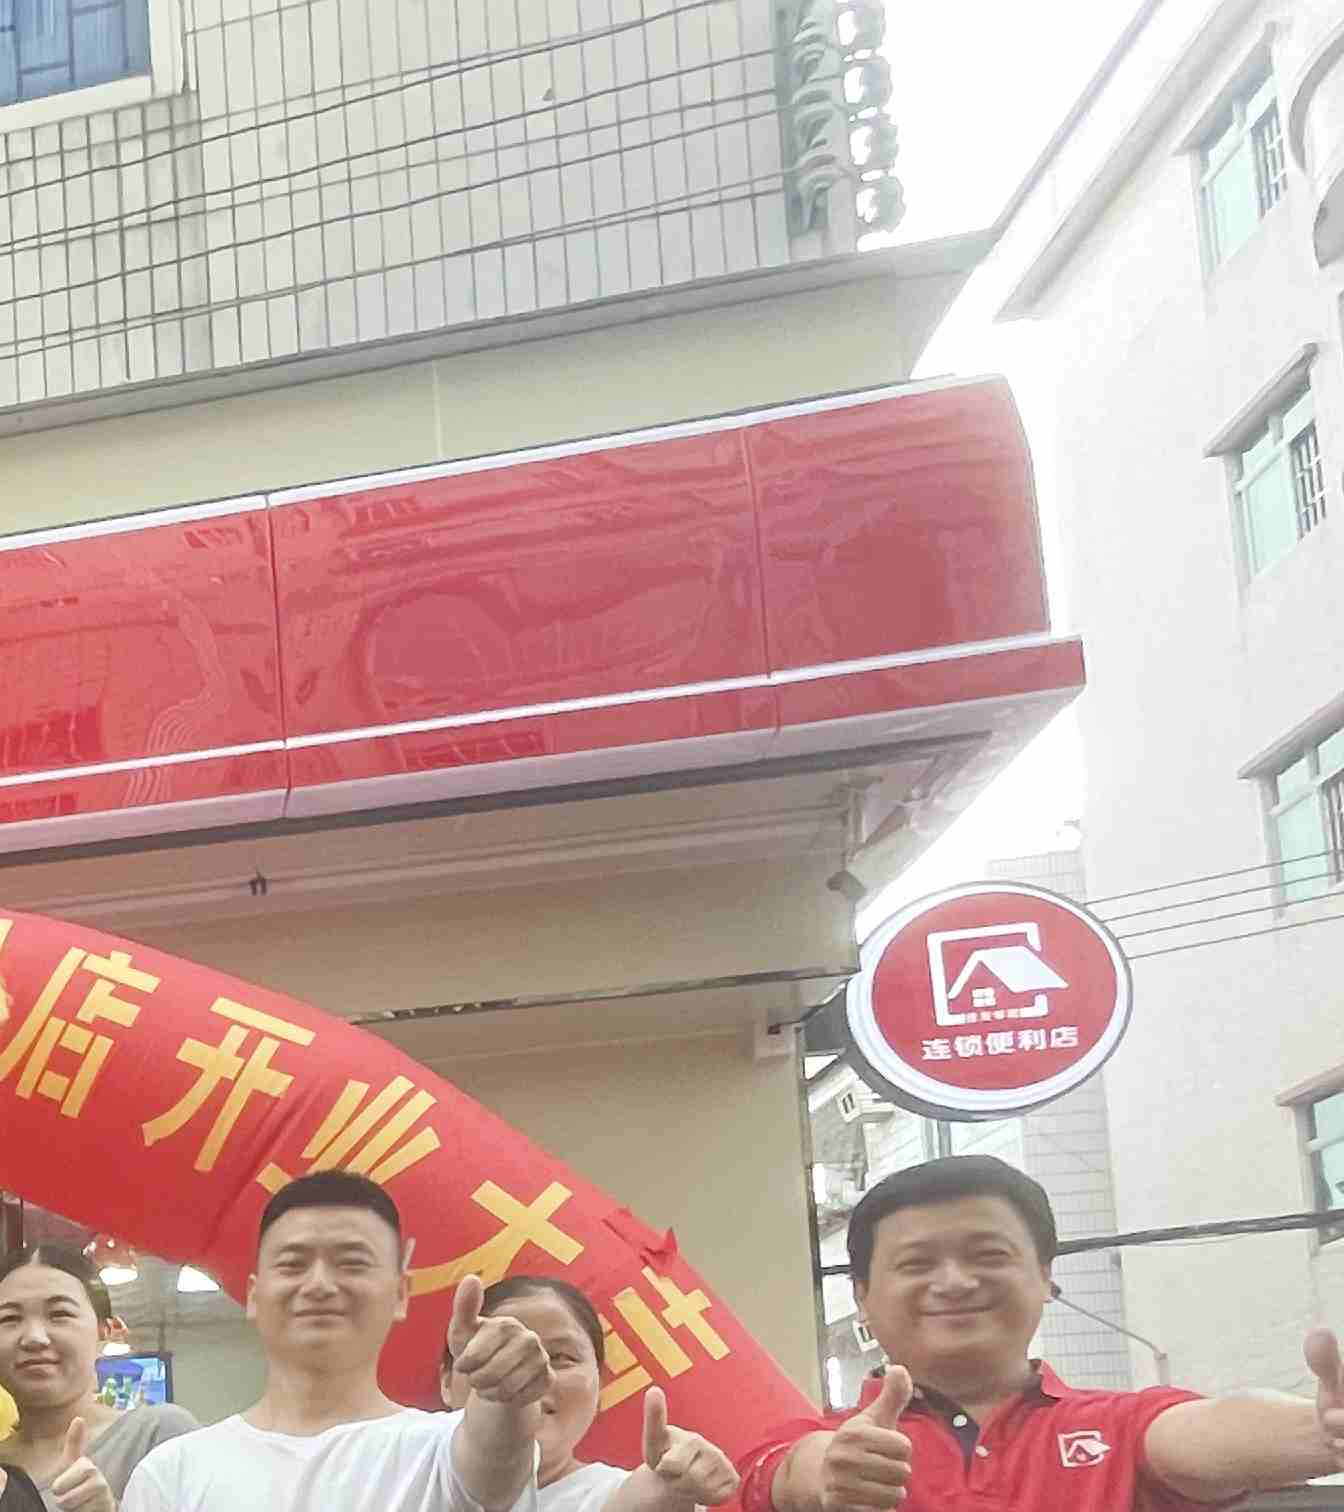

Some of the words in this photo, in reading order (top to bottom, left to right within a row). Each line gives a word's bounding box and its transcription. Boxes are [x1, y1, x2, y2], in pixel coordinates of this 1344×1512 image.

[921, 1026, 1080, 1061] 连锁便利店
